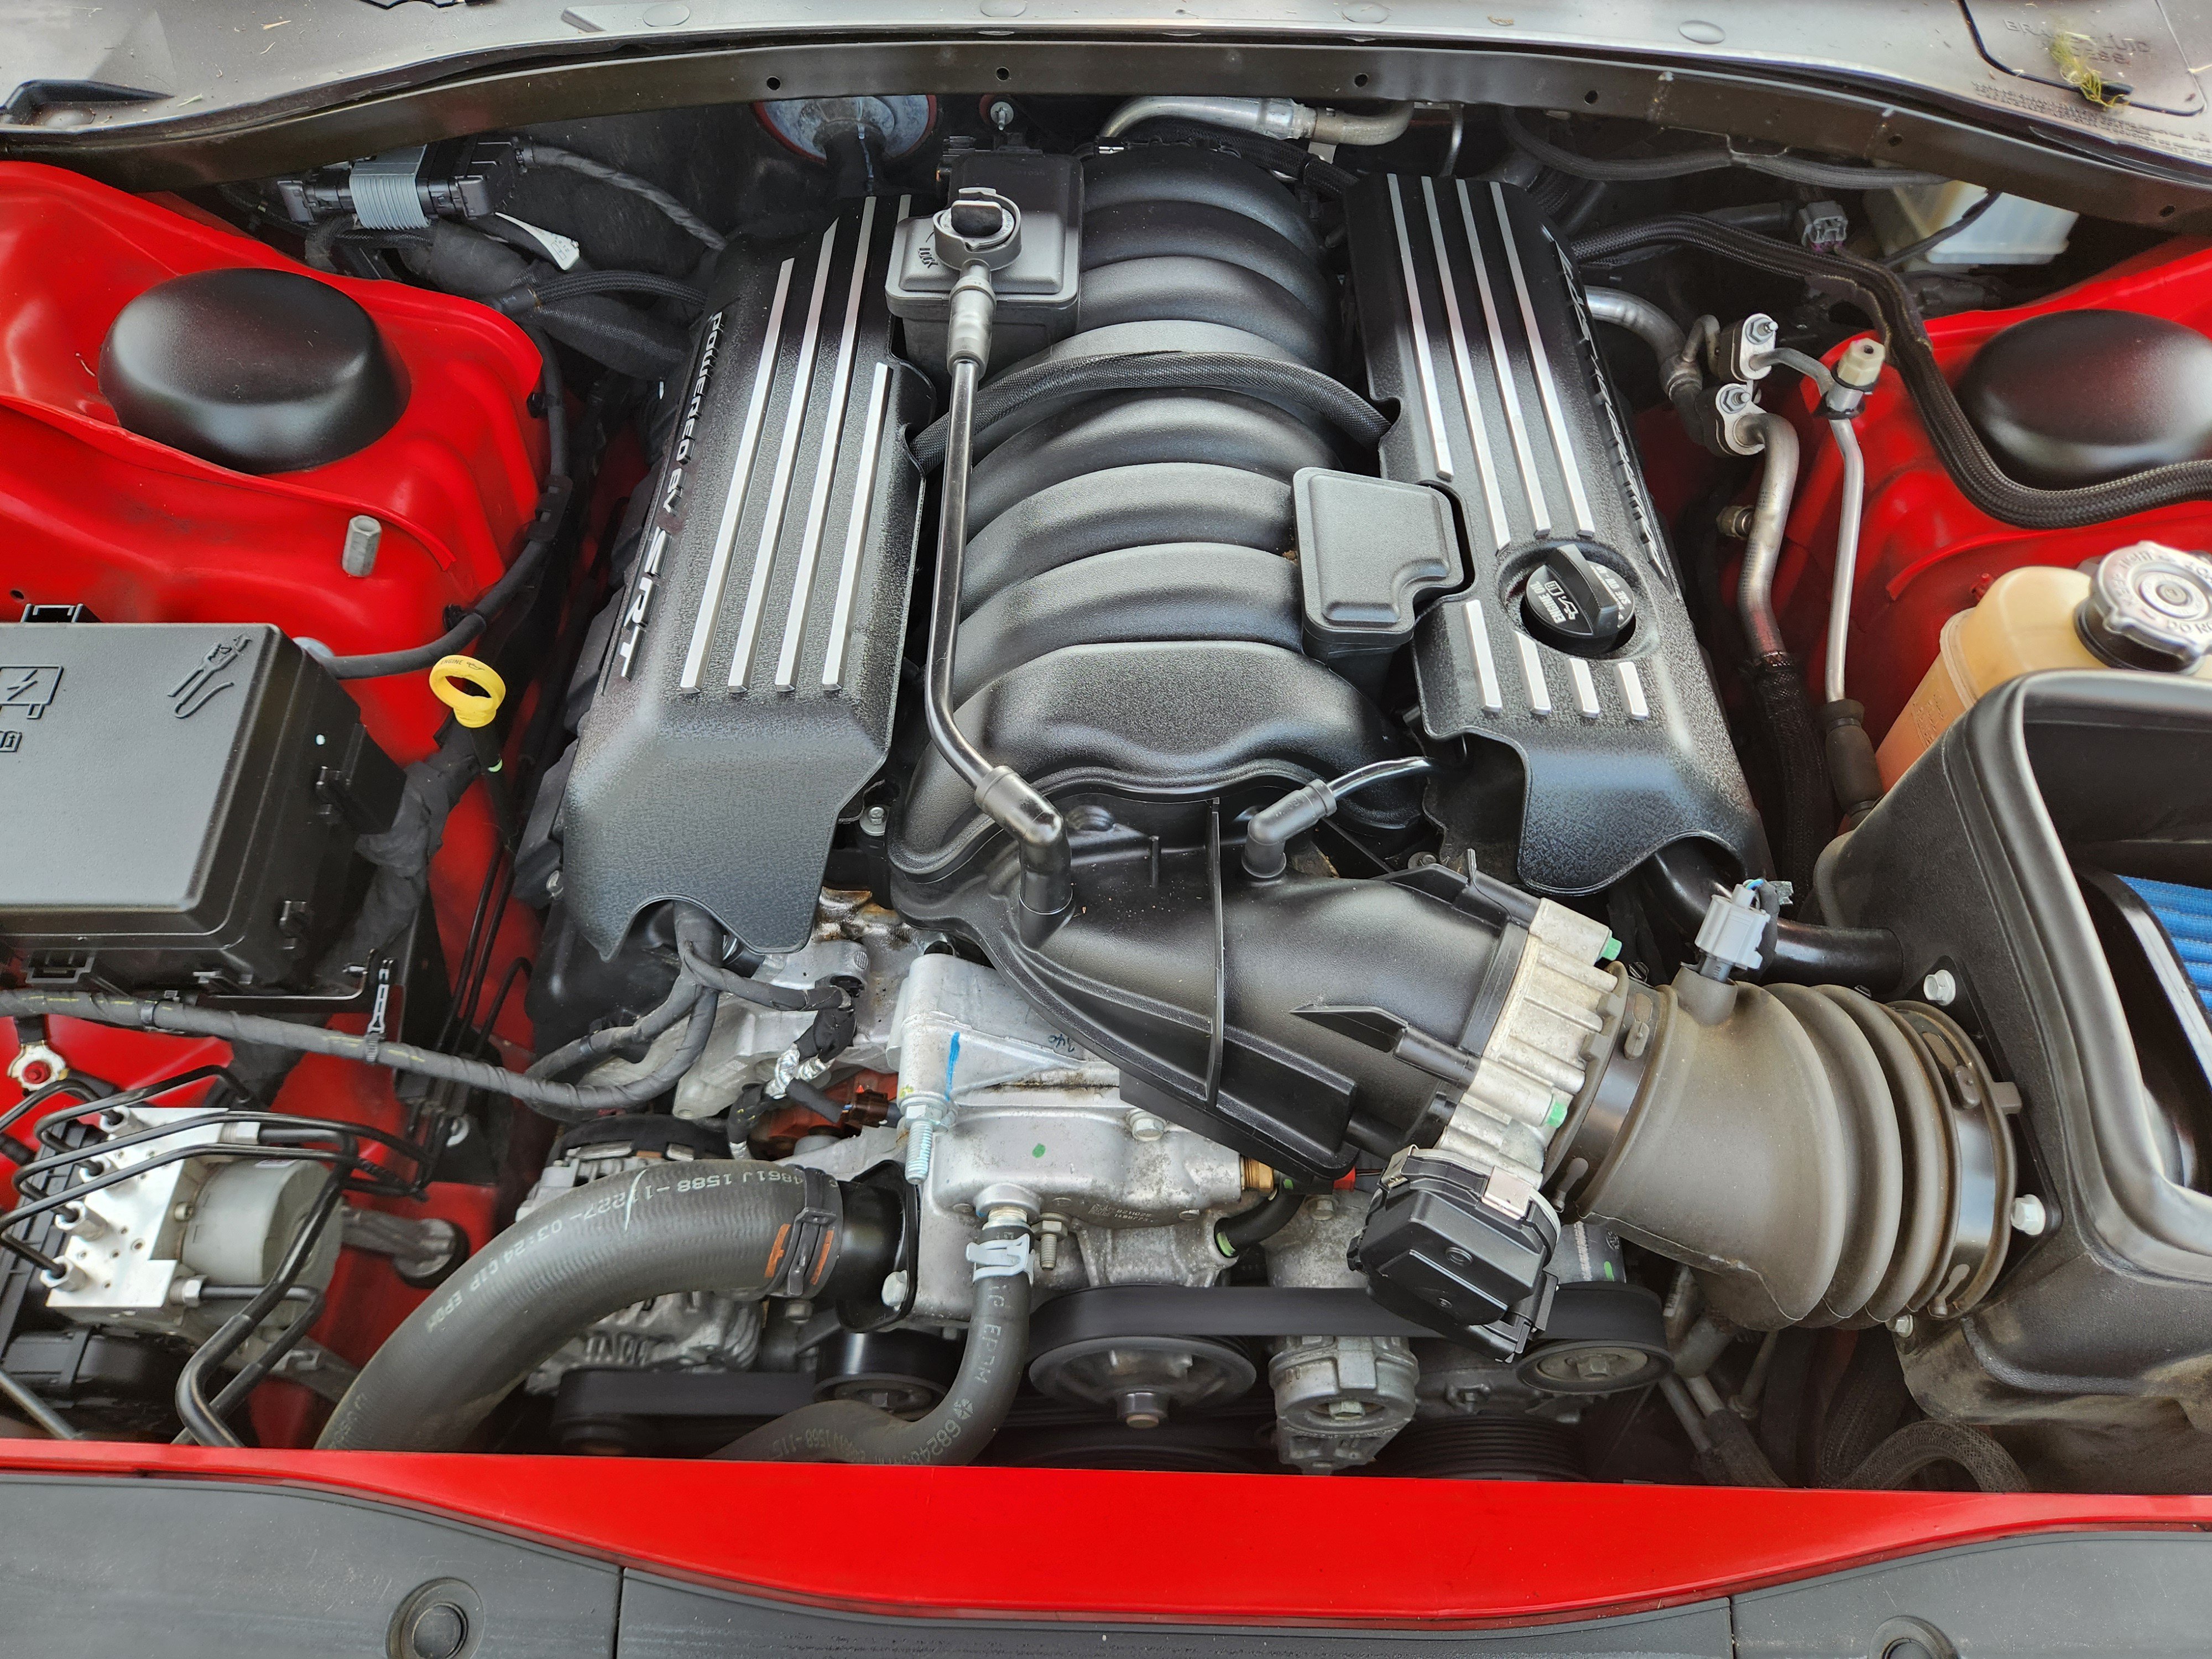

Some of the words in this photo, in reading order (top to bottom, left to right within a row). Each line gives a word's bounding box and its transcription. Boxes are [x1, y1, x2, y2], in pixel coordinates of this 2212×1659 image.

[676, 311, 723, 463] POWERED
[664, 468, 684, 515] BY
[620, 526, 669, 681] SRT
[1530, 581, 1547, 594] OIL
[1538, 592, 1567, 624] ENGINE
[676, 1172, 732, 1192] 1588
